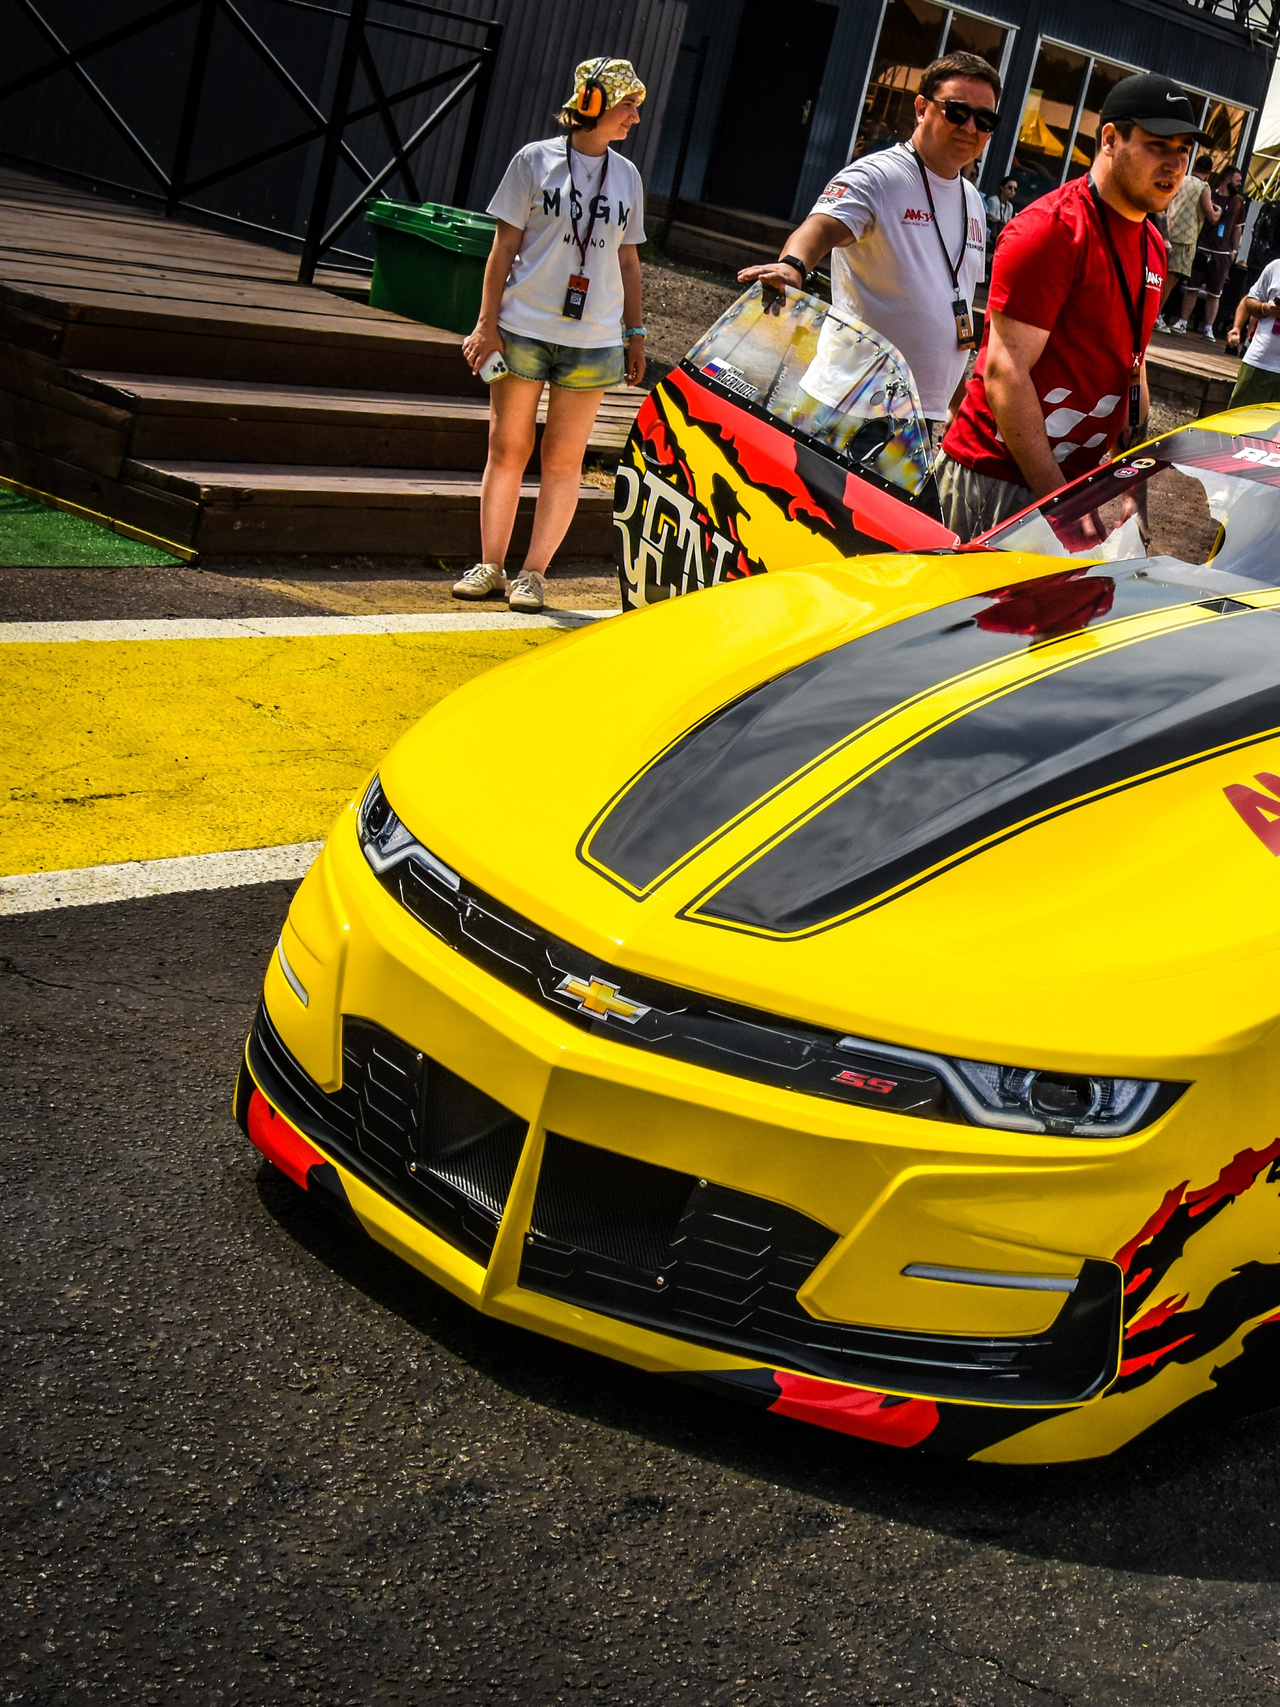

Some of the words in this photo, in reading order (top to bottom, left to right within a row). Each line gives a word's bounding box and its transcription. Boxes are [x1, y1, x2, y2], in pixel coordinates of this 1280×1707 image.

[542, 187, 630, 232] MSGM
[563, 234, 605, 249] MINO
[830, 1070, 898, 1094] SS
